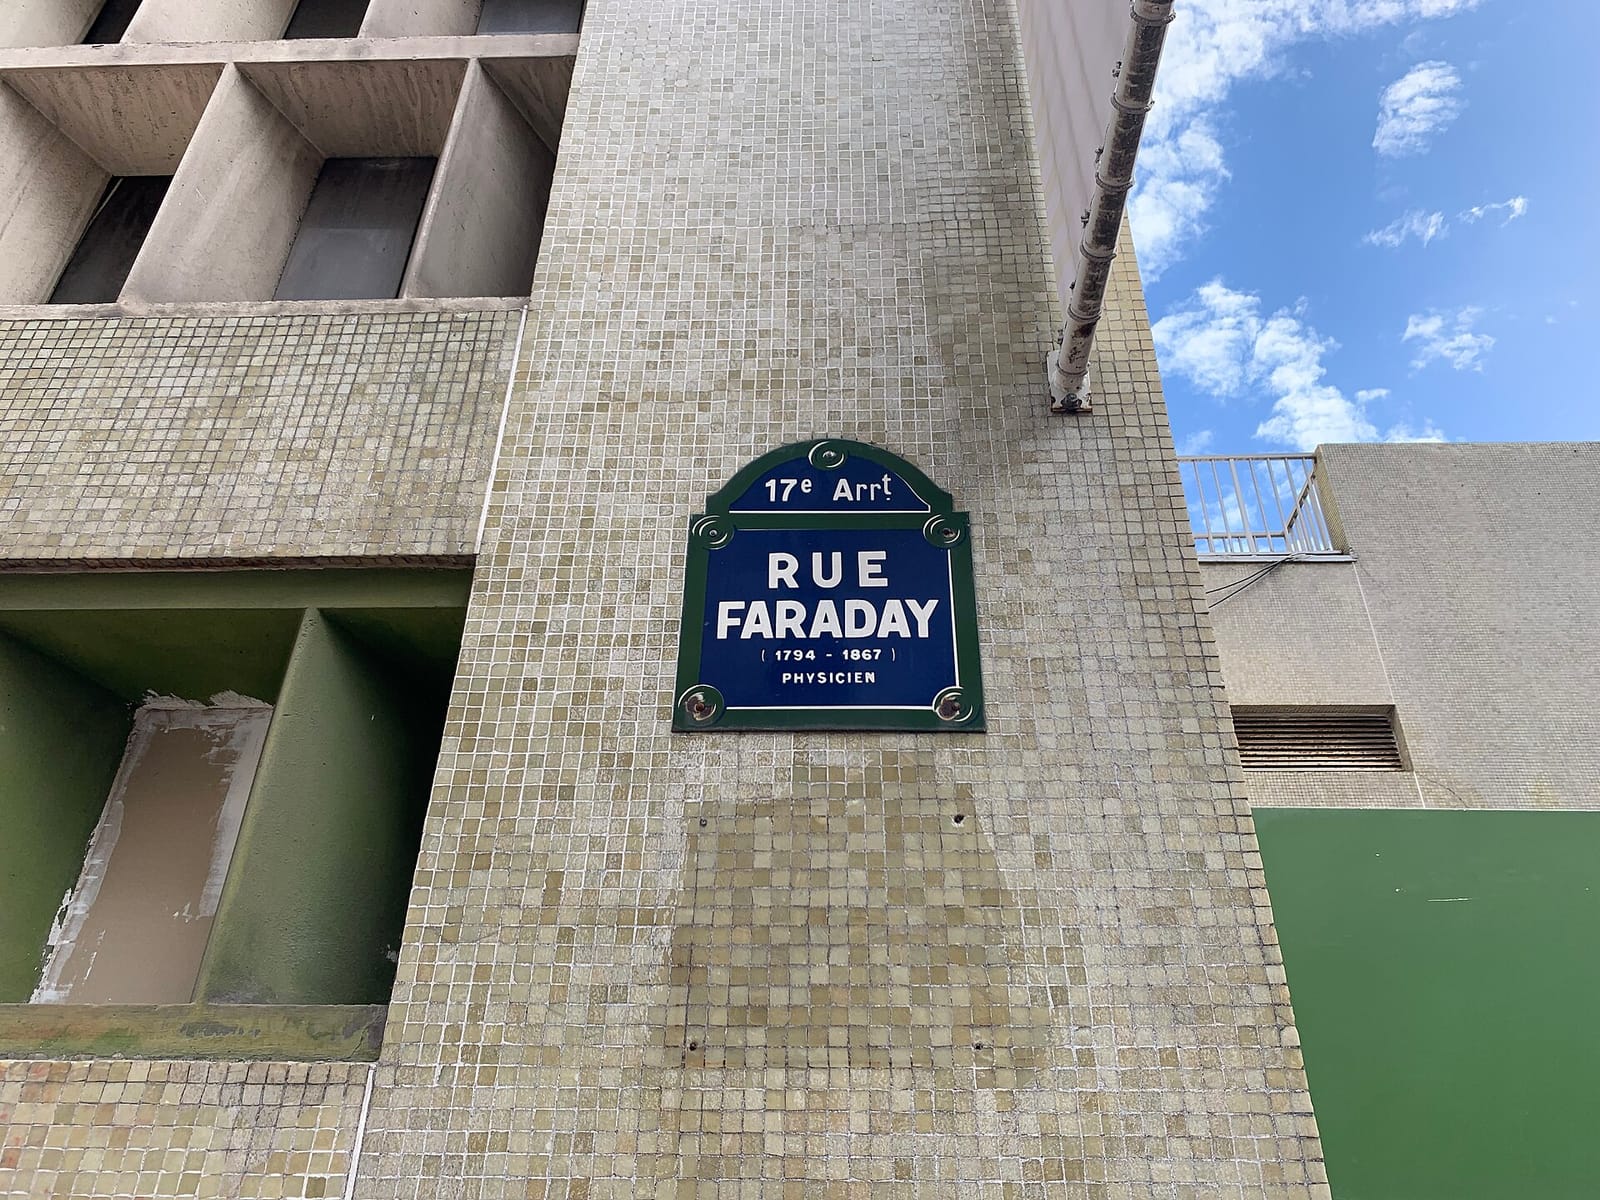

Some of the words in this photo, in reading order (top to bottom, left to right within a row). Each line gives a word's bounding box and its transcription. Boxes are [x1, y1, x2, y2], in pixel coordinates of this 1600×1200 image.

[768, 550, 889, 589] RUE
[716, 599, 940, 640] FARADAY
[782, 671, 876, 684] PHYSICIEN
